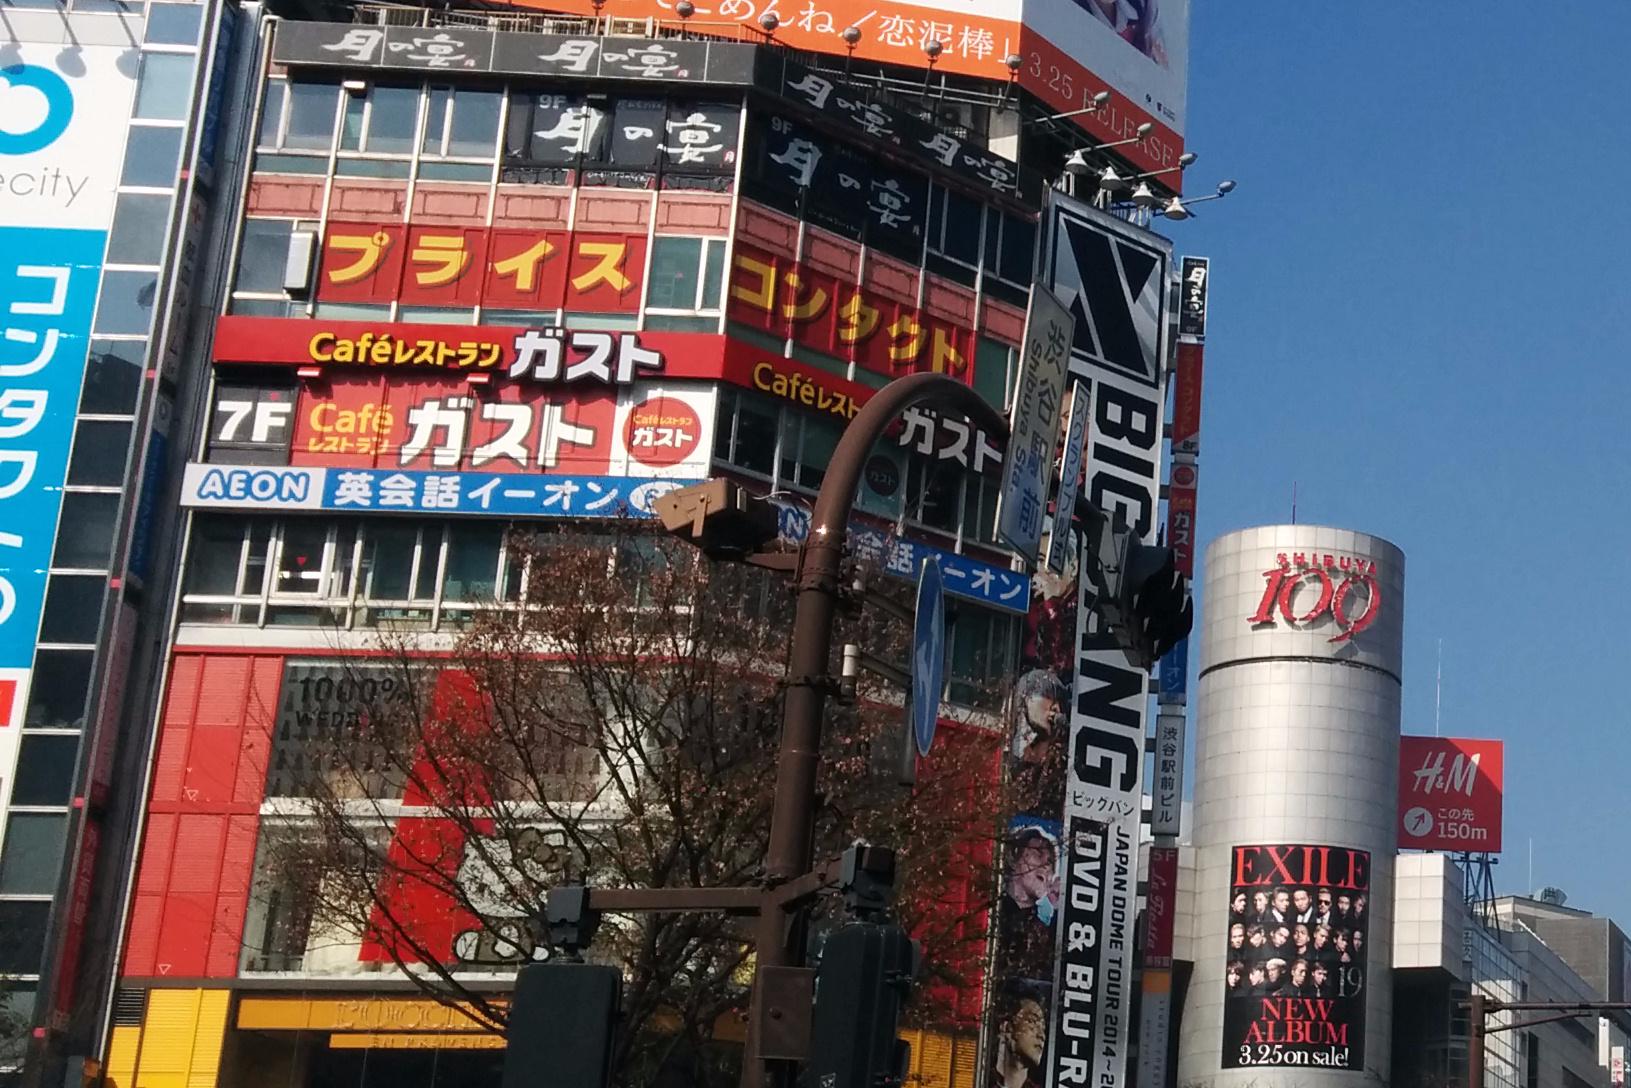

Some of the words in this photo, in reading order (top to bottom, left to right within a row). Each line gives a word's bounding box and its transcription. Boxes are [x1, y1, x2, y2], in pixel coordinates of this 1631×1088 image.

[1029, 52, 1073, 99] 3.25
[328, 232, 631, 292] プライス
[731, 254, 967, 374] コンタクト
[509, 328, 661, 382] ガスト
[1019, 339, 1042, 436] Shibuya
[215, 399, 293, 442] 7F
[308, 402, 394, 433] Café
[401, 395, 597, 469] ガスト
[632, 426, 694, 448] ガスト
[898, 405, 1003, 474] ガスト
[308, 433, 390, 455] レストラン
[198, 470, 312, 501] AEON
[334, 475, 619, 513] 英会話イーオン
[856, 530, 1022, 600] 会話ーオン
[1277, 551, 1377, 576] SHIBUYA
[1246, 567, 1381, 643] 109
[1157, 726, 1178, 824] 渋谷駅前ビル
[1413, 751, 1481, 797] H&M
[1071, 789, 1135, 818] ビッグバン
[1438, 807, 1475, 821] この先
[1437, 822, 1488, 840] 150m
[1071, 830, 1103, 913] DVD
[1107, 825, 1130, 892] JAPAN
[1232, 845, 1370, 892] EXILE
[1067, 920, 1097, 954] &
[1107, 893, 1128, 953] DOME
[1104, 956, 1123, 1011] TOUR
[1338, 966, 1364, 998] 19
[1057, 961, 1095, 1088] BLU-R
[1259, 998, 1335, 1022] NEW
[1242, 1021, 1350, 1046] ALBUM
[1312, 1046, 1350, 1067] sale!
